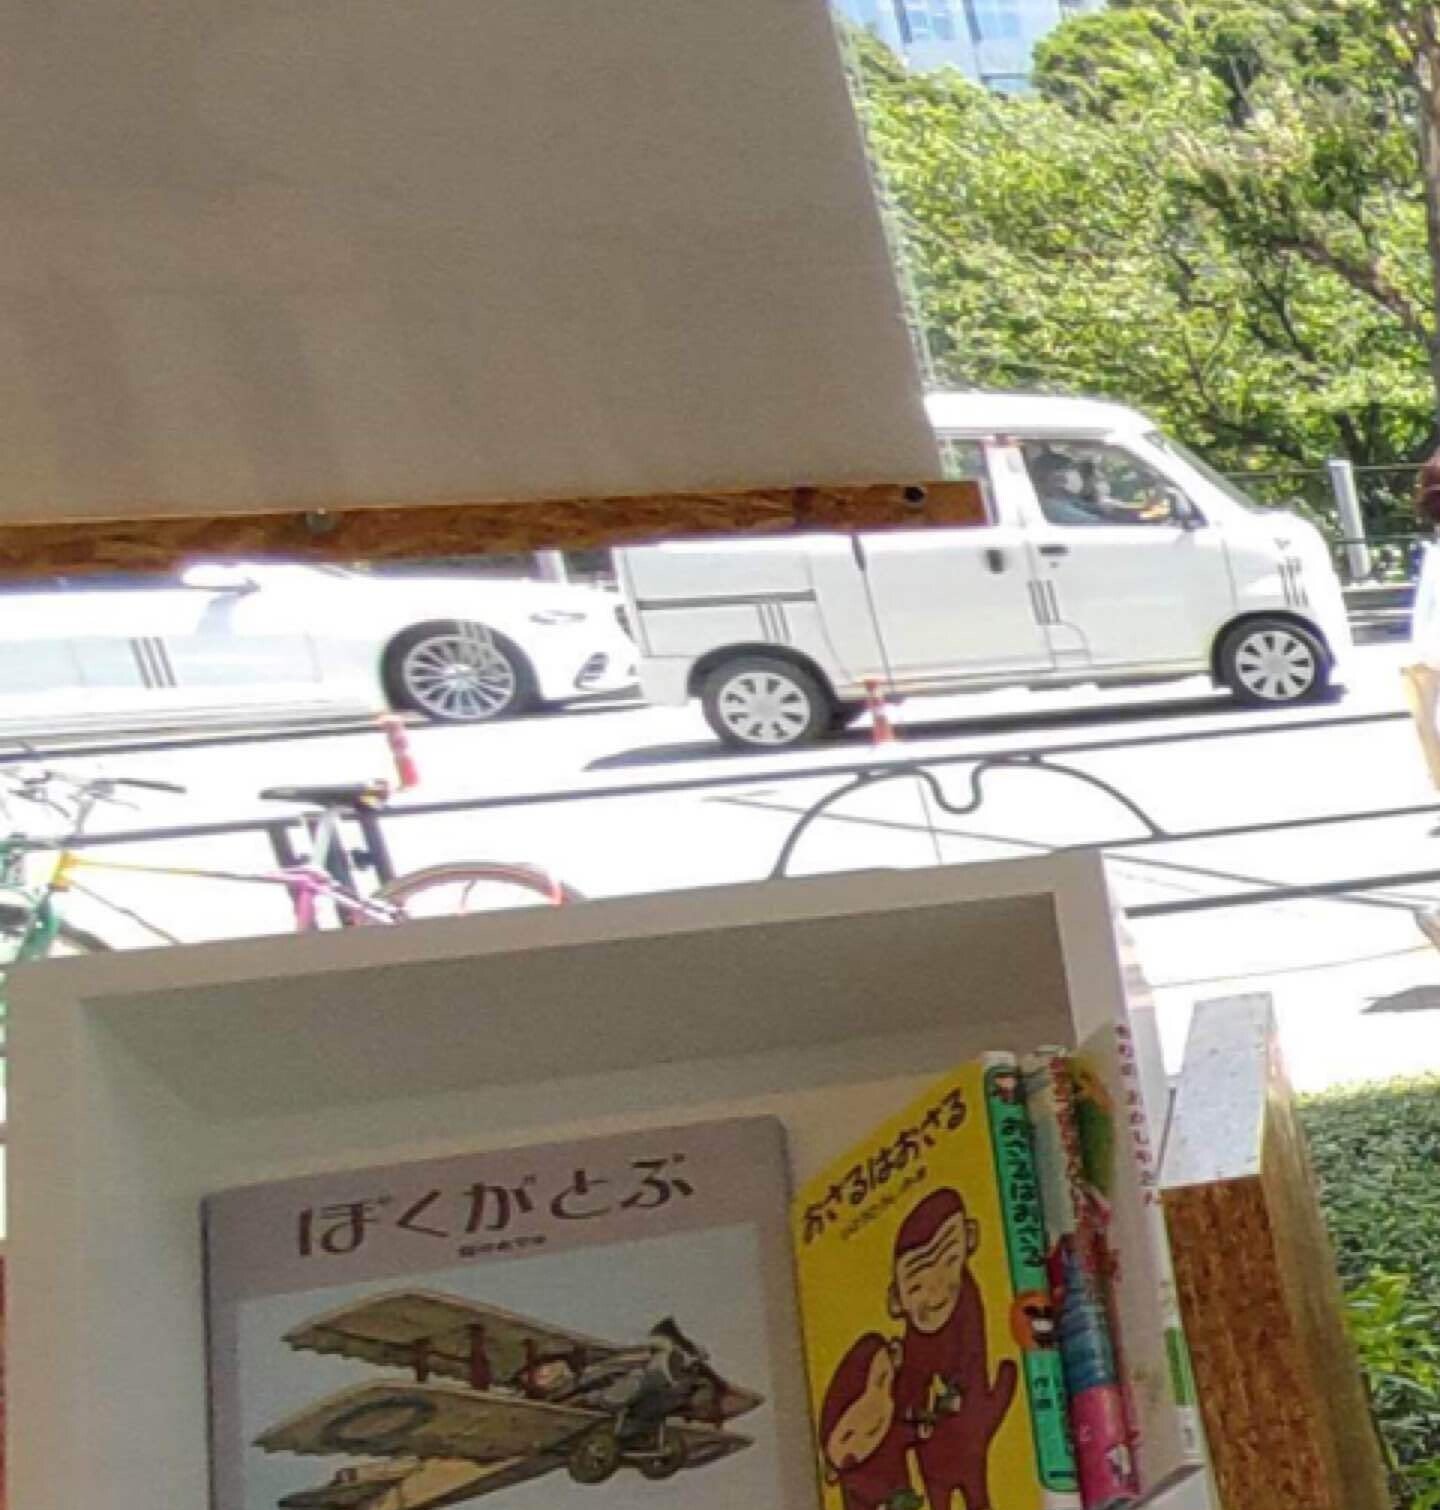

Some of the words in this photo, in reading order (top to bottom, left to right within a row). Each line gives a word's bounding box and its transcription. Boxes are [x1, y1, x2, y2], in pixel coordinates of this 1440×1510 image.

[297, 1152, 695, 1257] ぼくがとぶ
[800, 1087, 969, 1246] おさるはおさる
